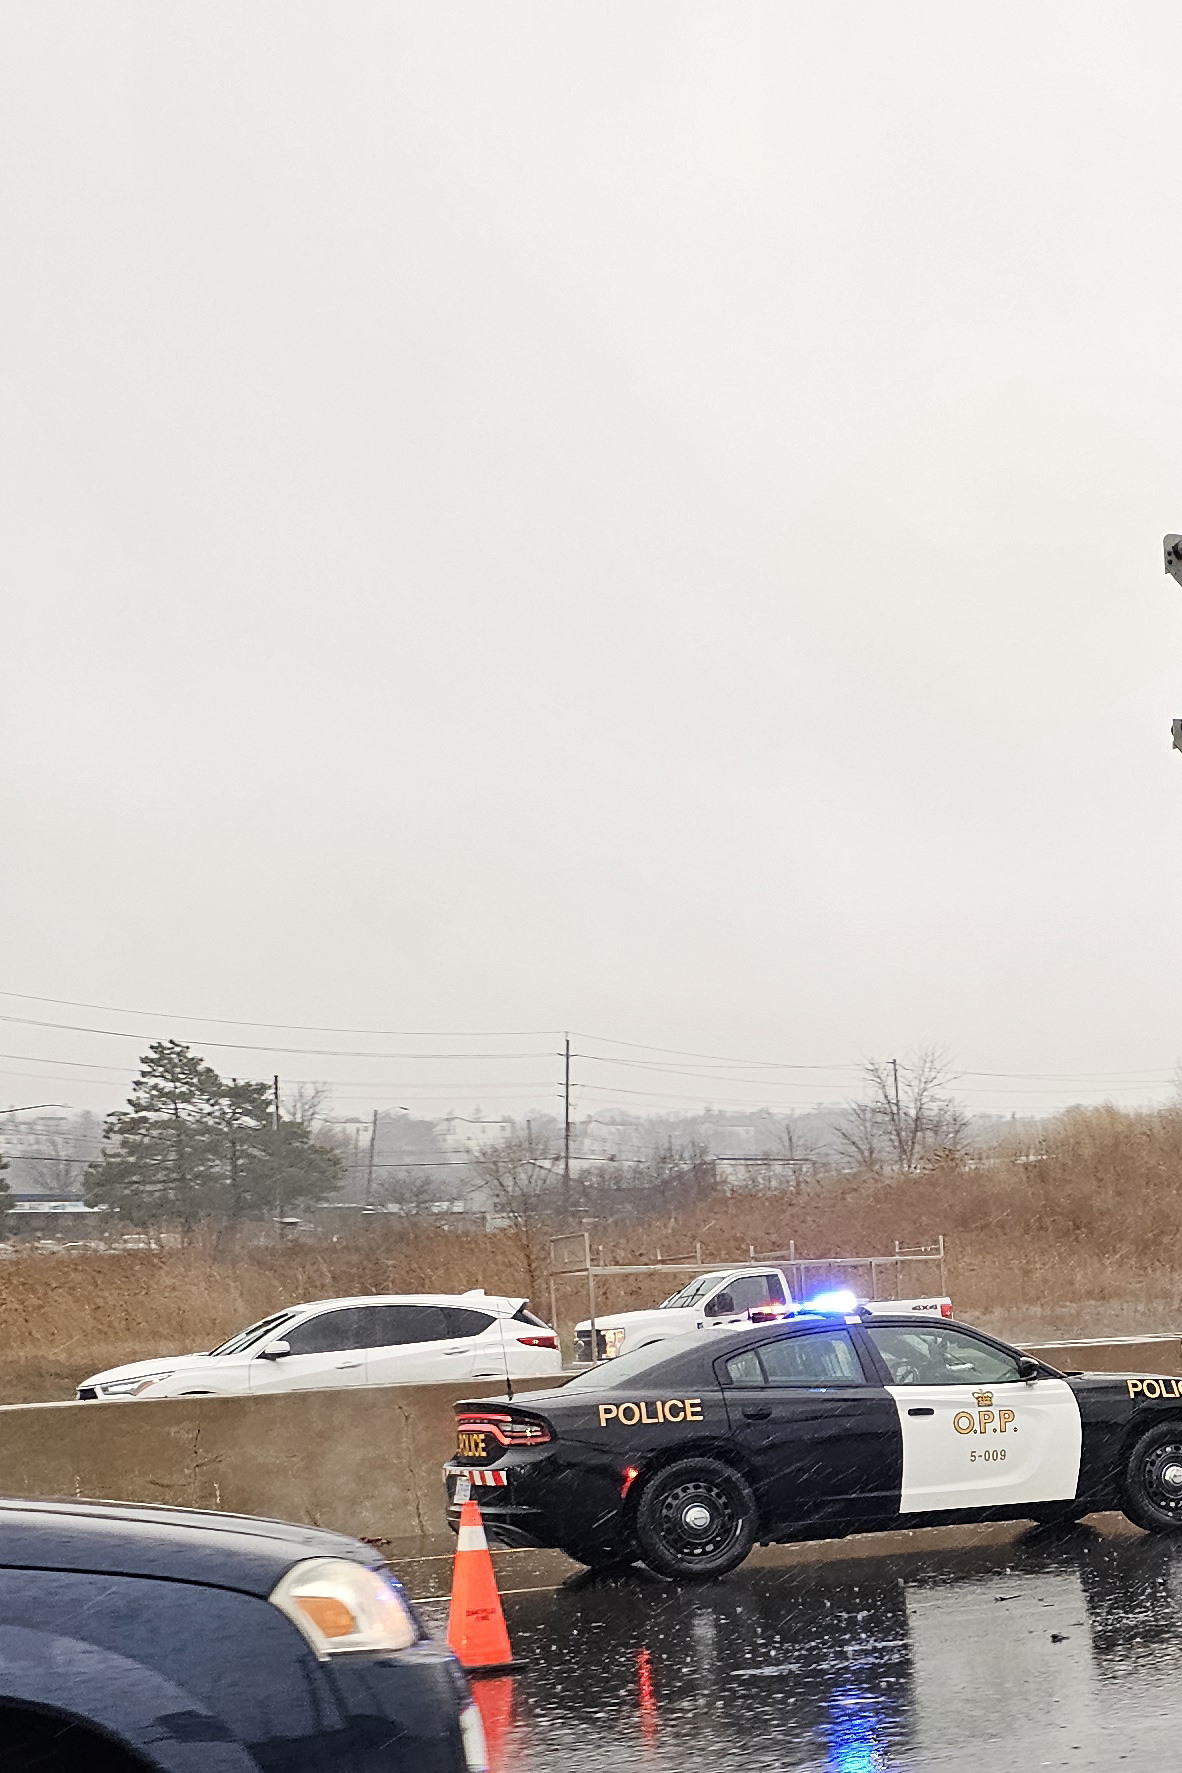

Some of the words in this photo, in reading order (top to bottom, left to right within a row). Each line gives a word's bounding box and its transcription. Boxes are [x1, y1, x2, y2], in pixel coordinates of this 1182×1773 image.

[598, 1398, 704, 1427] POLICE
[953, 1409, 1018, 1434] O.P.P.
[970, 1449, 1007, 1462] 5-009
